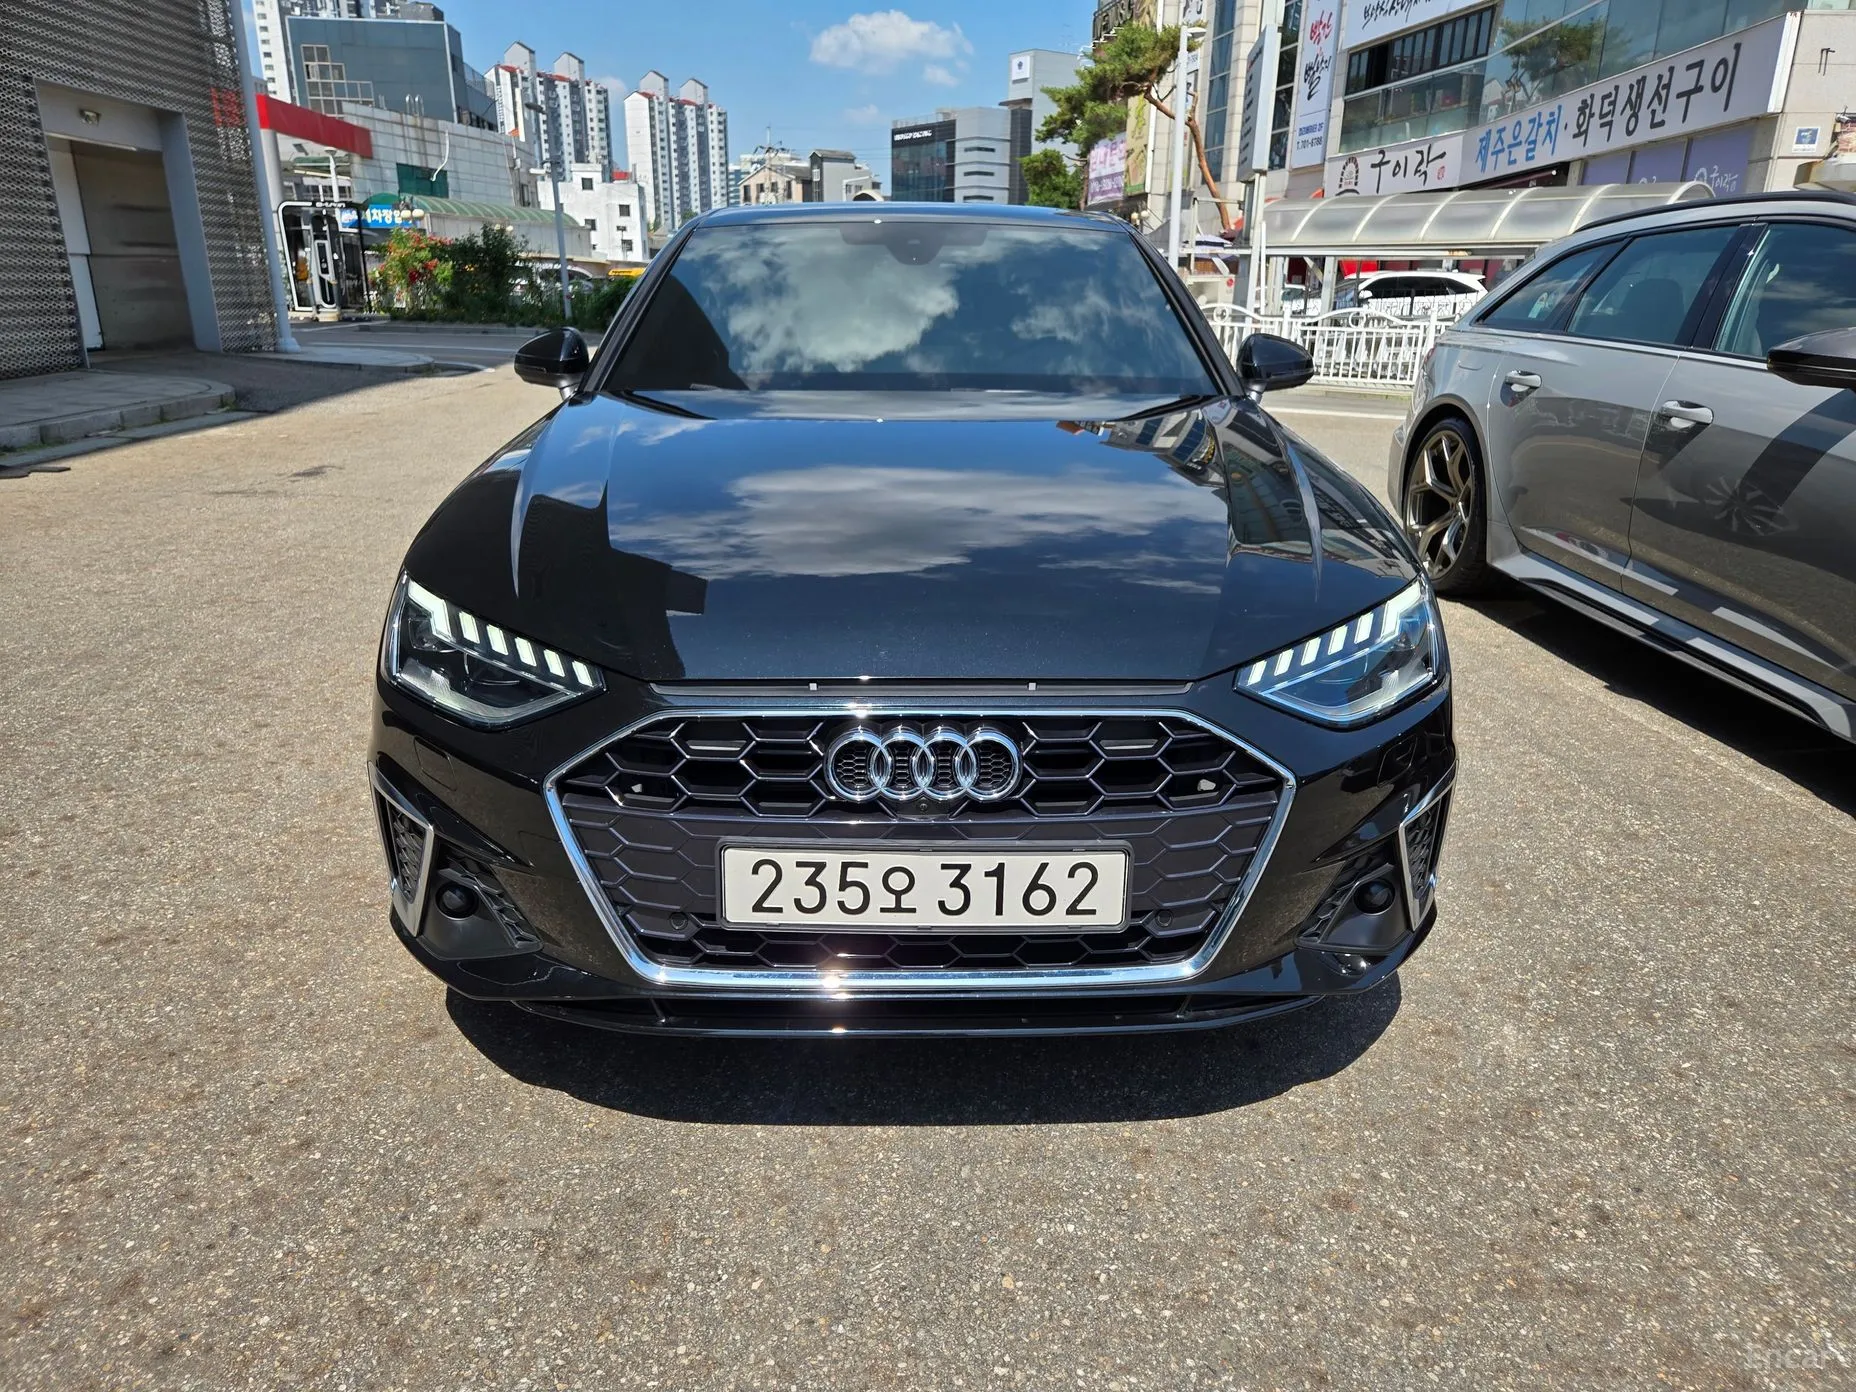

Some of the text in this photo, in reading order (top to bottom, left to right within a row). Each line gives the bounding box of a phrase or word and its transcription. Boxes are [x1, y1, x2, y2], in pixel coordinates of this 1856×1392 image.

[1475, 42, 1742, 174] 제주은갈치 화덕생선구이
[1370, 144, 1447, 194] 구이락
[751, 858, 1099, 916] 235오 3162
